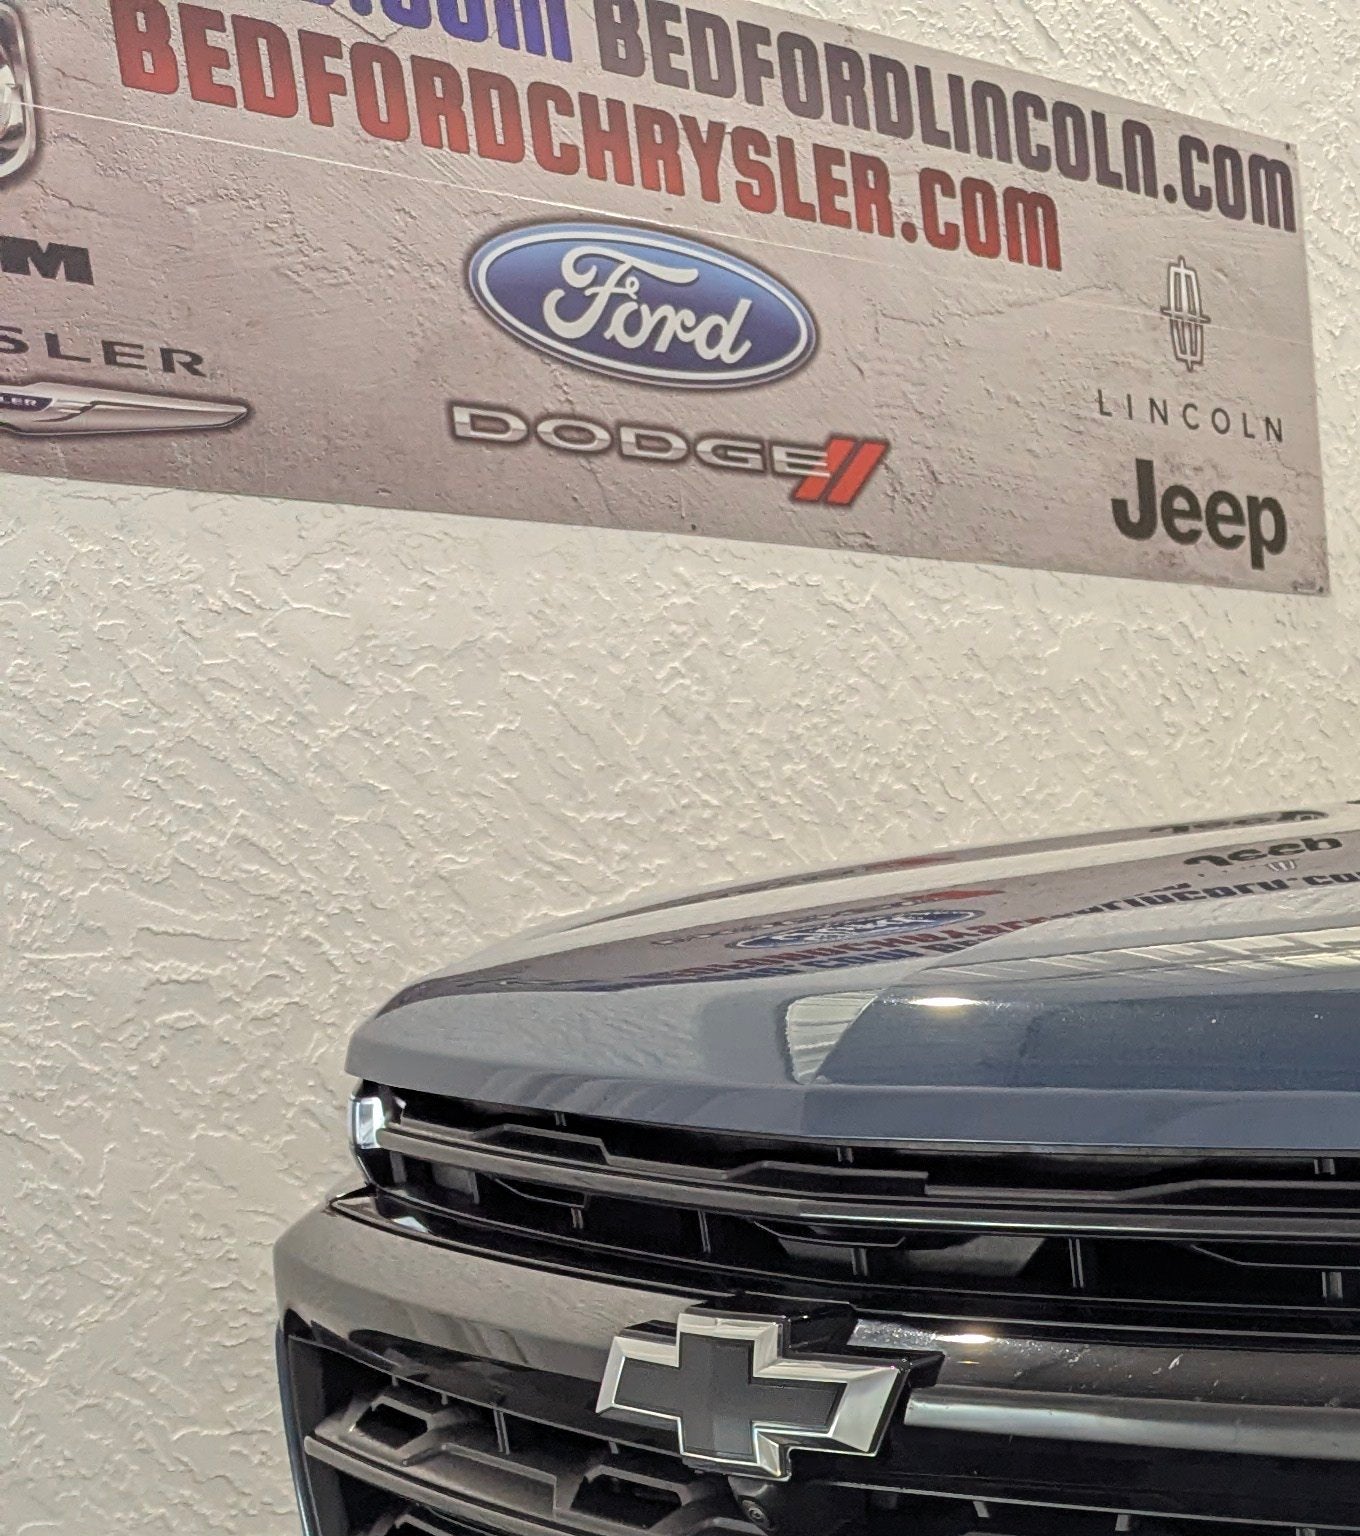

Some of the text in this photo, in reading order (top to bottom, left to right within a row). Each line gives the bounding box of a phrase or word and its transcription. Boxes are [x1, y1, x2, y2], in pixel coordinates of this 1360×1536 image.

[112, 0, 1063, 271] BEDFORDCHRYSLER.COM
[543, 246, 753, 364] Ford
[448, 402, 830, 478] DODGE
[1097, 389, 1284, 443] LINCOLN
[1110, 458, 1288, 570] Jeep
